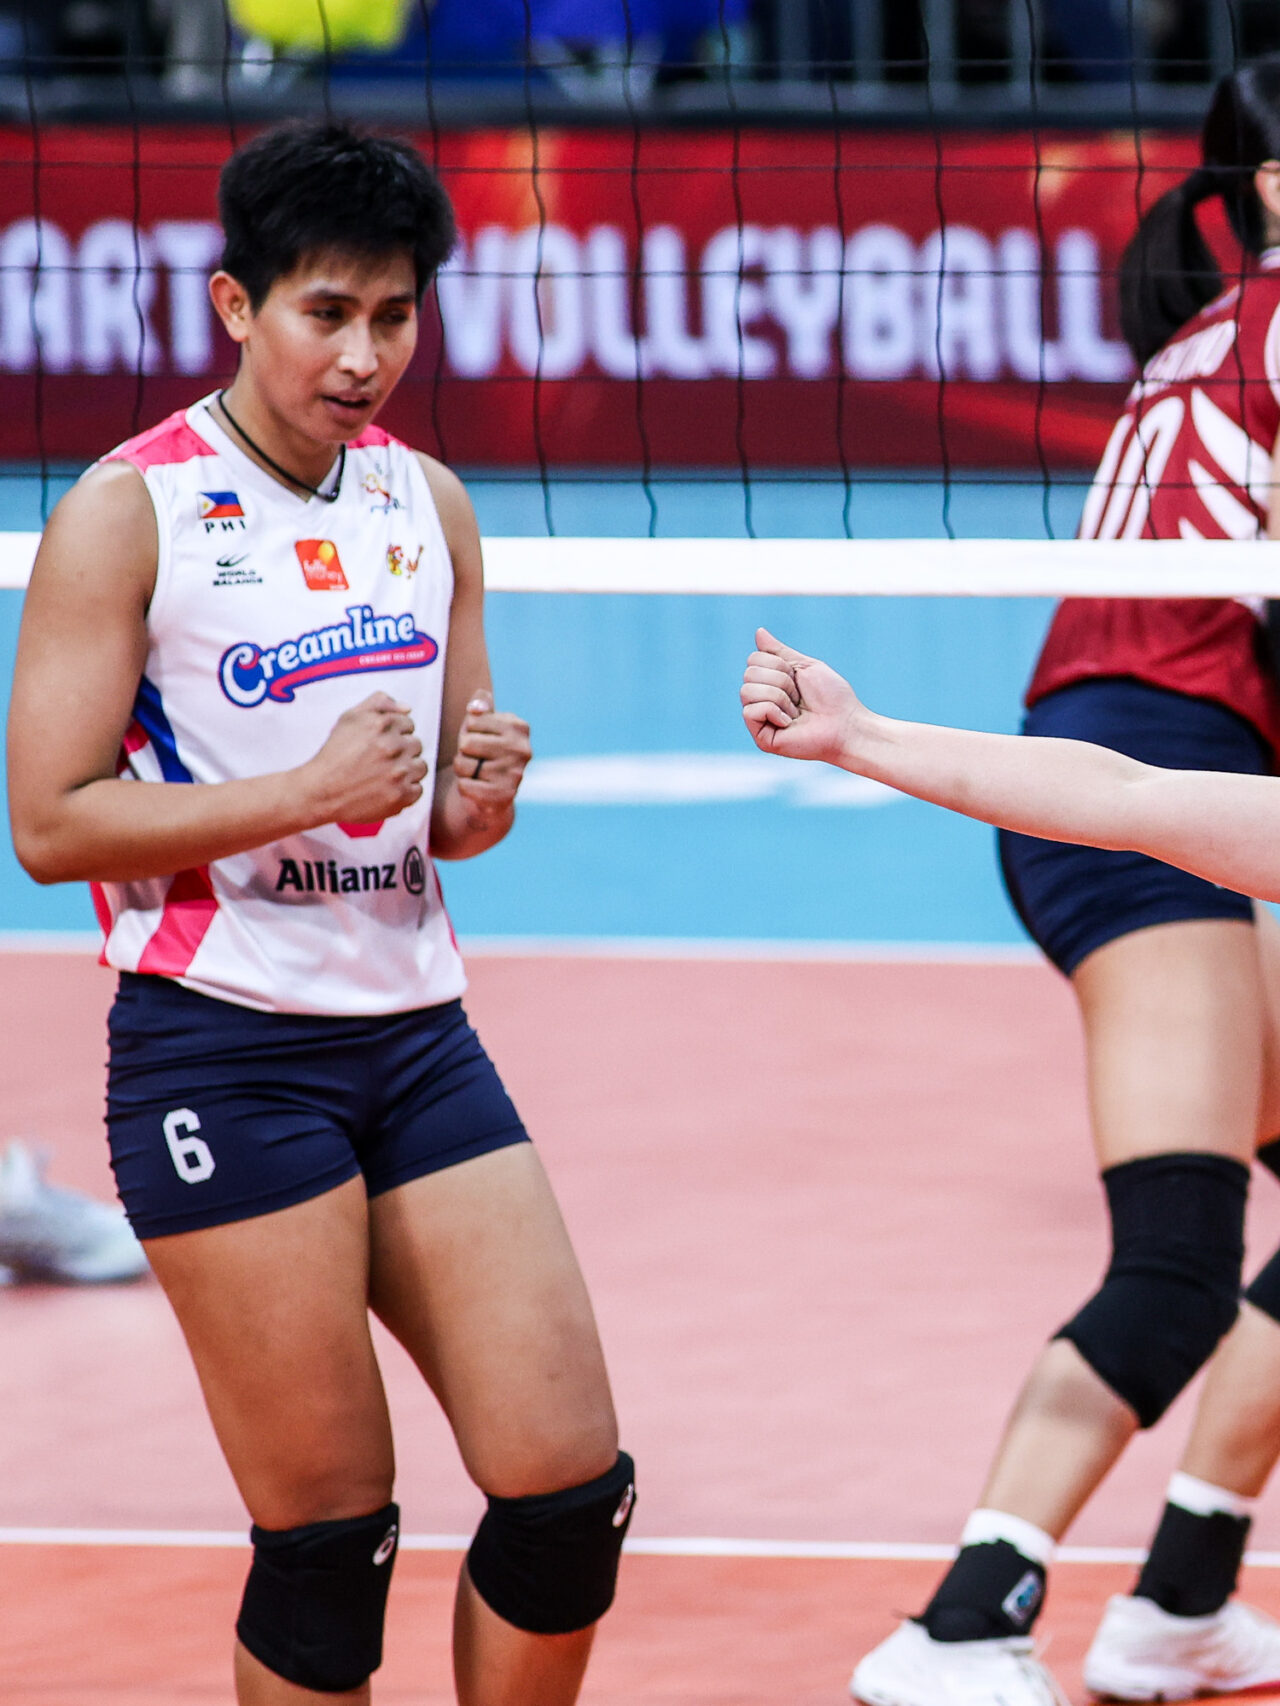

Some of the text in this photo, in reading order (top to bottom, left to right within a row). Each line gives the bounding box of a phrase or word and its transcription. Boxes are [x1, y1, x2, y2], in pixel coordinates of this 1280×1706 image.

[437, 222, 1138, 382] VOLLEYBALL
[205, 519, 246, 534] PHI
[221, 608, 415, 706] Creamline
[276, 858, 397, 893] Allianz
[163, 1107, 216, 1185] 6
